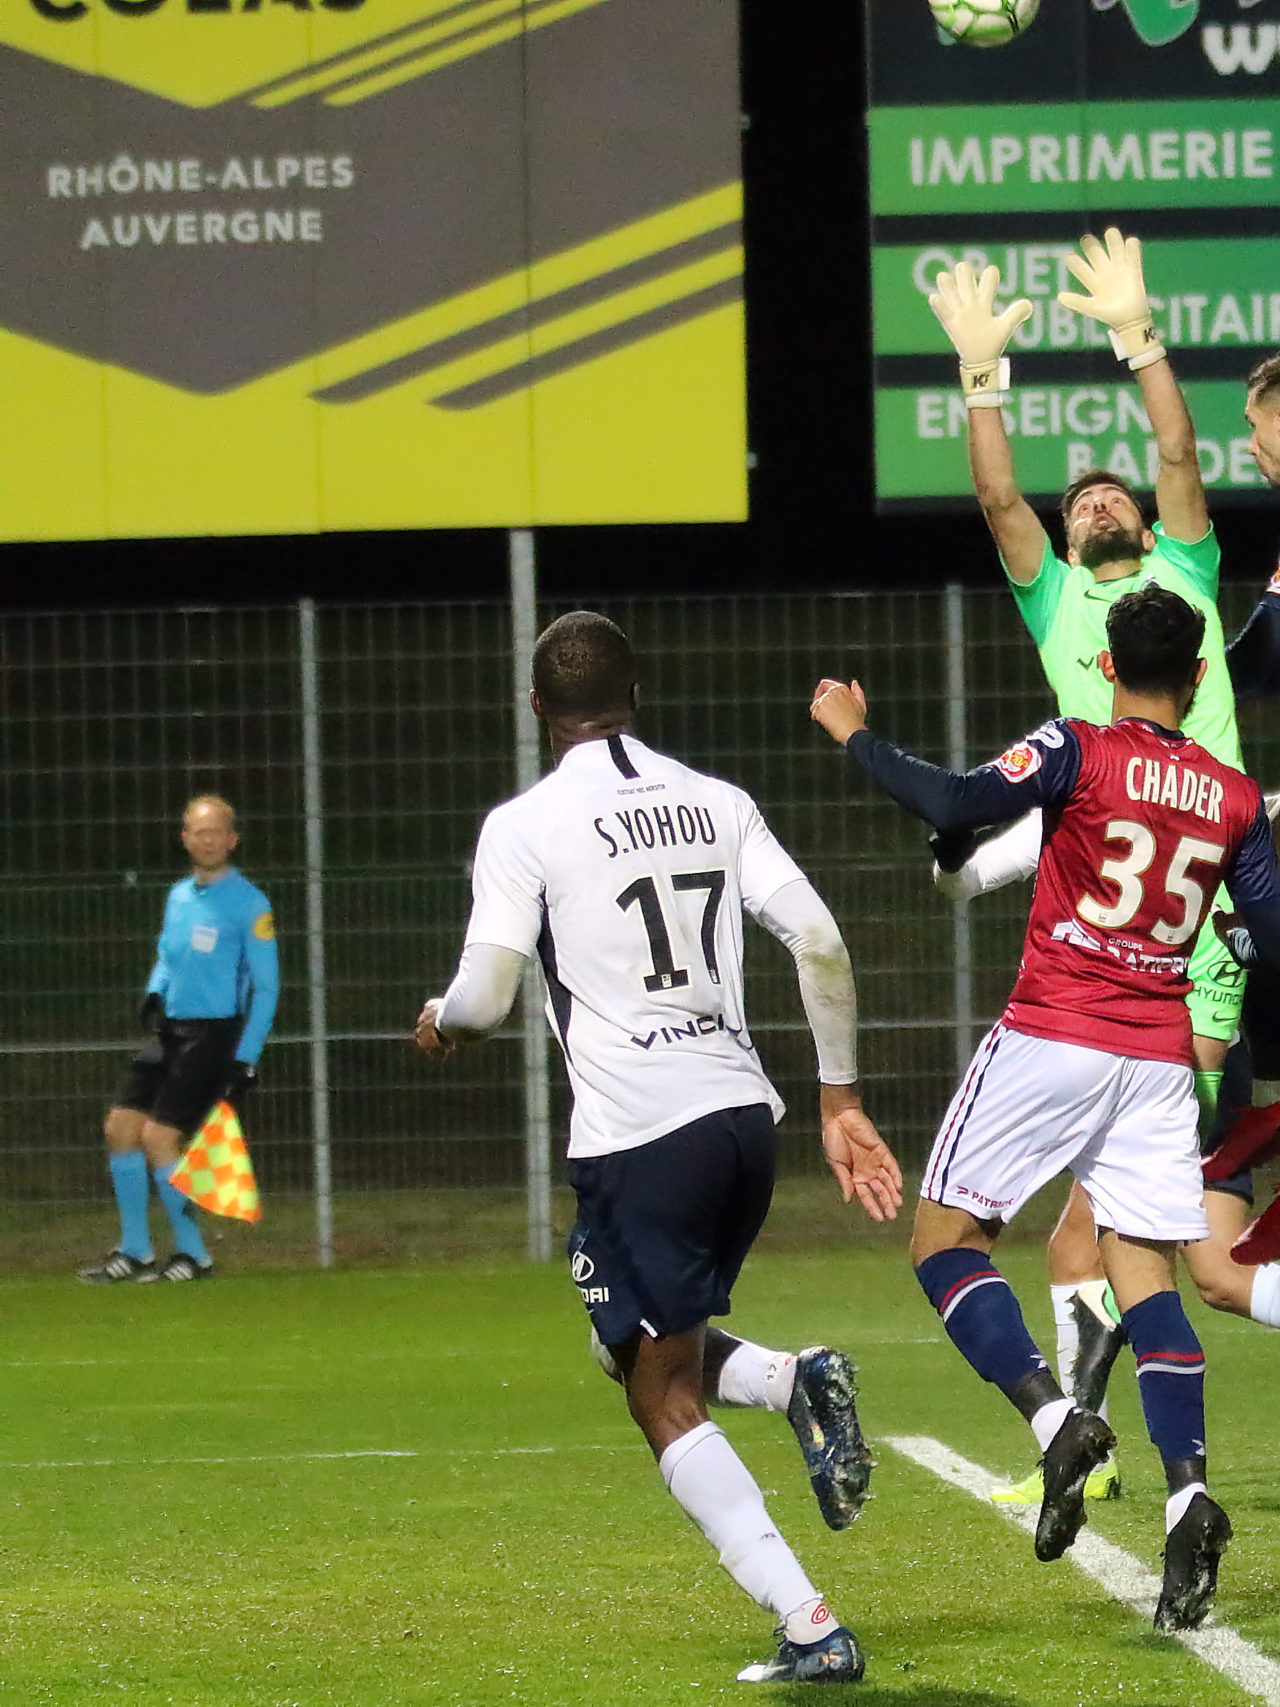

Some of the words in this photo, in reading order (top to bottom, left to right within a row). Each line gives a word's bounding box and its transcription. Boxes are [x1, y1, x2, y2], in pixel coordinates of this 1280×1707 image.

[48, 154, 355, 198] RHÔNE-ALPES
[909, 130, 1274, 186] IMPRIMERIE
[80, 208, 322, 250] AUVERGNE
[1126, 756, 1224, 824] CHADER
[594, 804, 717, 859] S.YOHOU
[1076, 820, 1225, 945] 35
[615, 868, 727, 993] 17
[1108, 937, 1144, 951] GROUPE
[630, 1013, 725, 1050] VINCI
